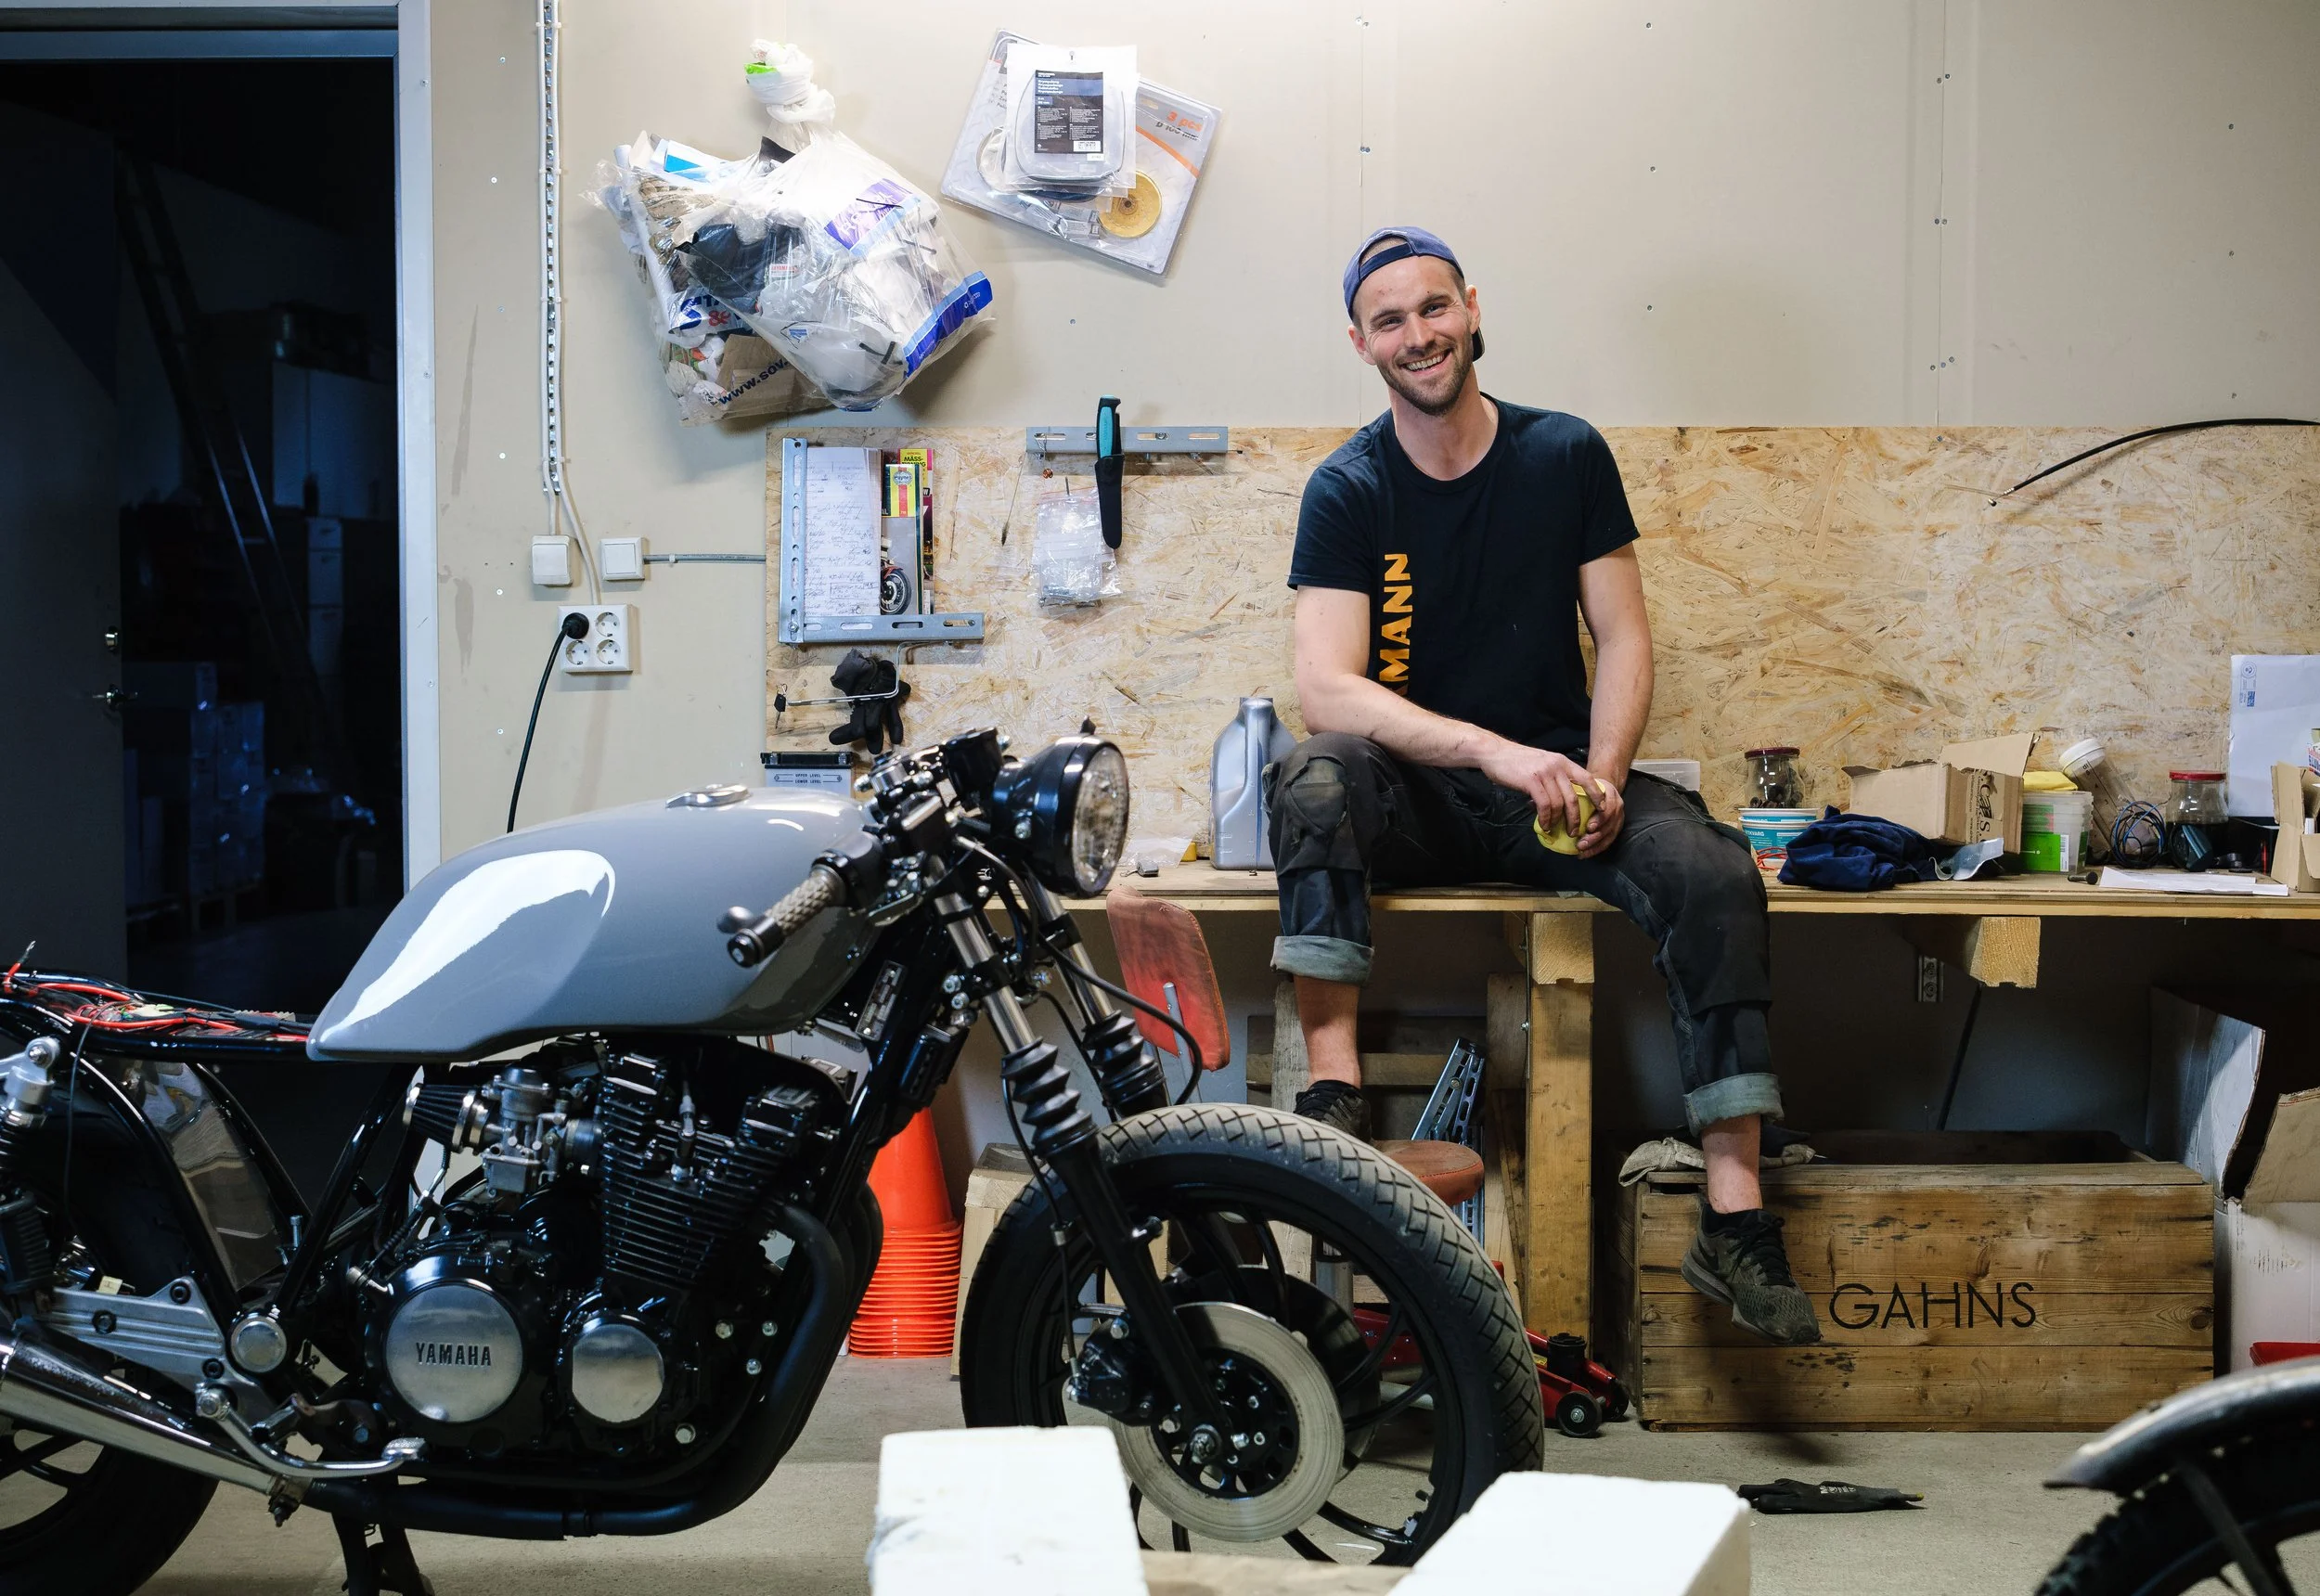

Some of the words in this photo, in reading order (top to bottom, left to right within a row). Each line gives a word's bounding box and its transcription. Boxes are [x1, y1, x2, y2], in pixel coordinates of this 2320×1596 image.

[1379, 554, 1412, 695] MANN
[1829, 1281, 2037, 1330] GAHNS
[416, 1342, 492, 1366] YAMAHA
